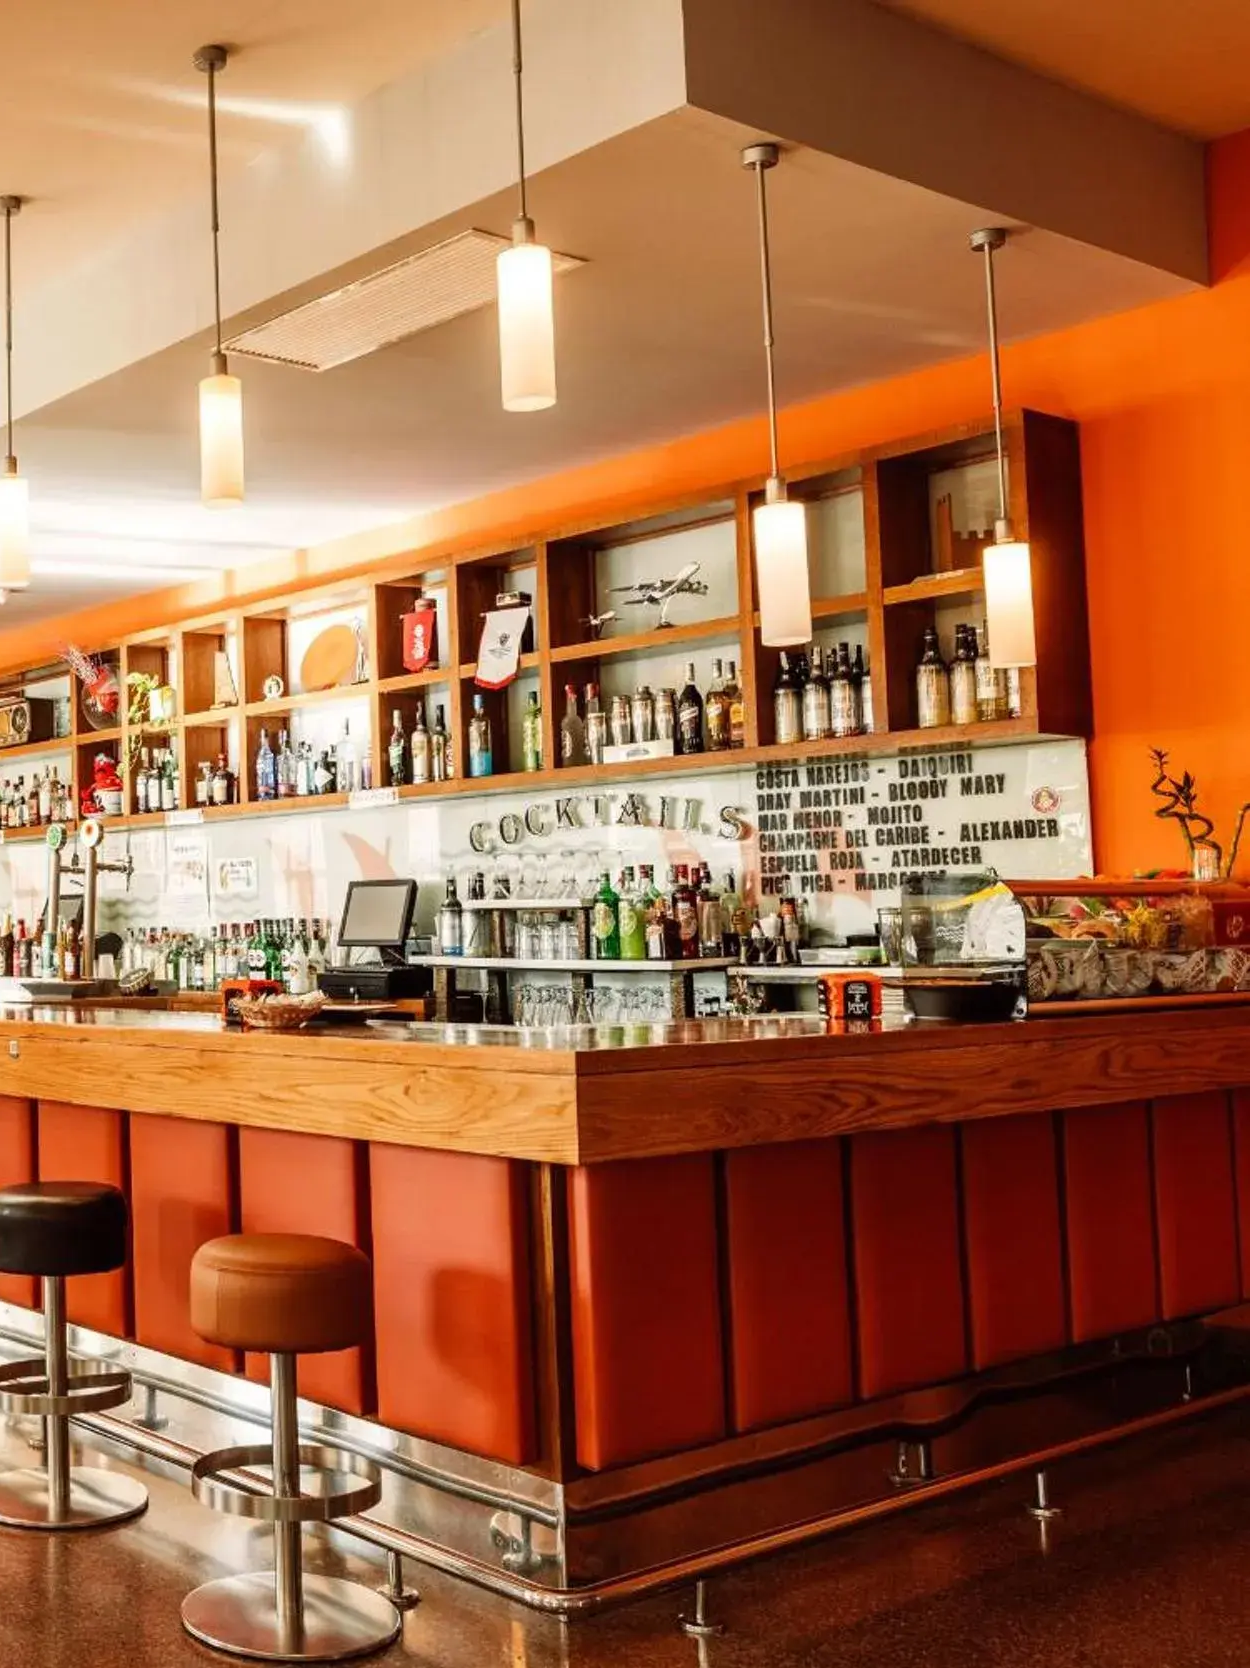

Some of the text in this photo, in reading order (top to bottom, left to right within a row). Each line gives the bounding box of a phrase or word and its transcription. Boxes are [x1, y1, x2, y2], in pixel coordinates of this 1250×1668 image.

[756, 769, 800, 790] COSTA
[806, 762, 870, 785] NAREJOS
[898, 754, 973, 778] DAIQUIRI
[757, 793, 791, 811] DRAY
[800, 786, 865, 808] MARTINI
[888, 779, 947, 802] BLOODY
[960, 774, 1006, 796] MARY
[469, 793, 747, 852] COCKTAILS
[758, 813, 787, 832] MAR
[793, 809, 842, 830] MENOR
[867, 804, 922, 825] MOJITO
[759, 831, 837, 853] CHAMPAGNE
[845, 829, 869, 848] DEL
[875, 826, 929, 846] CARIBE
[960, 819, 1059, 842] ALEXANDER
[760, 854, 818, 873] ESPUELA
[829, 851, 865, 870] ROJA
[891, 846, 982, 867] ATARDECER
[801, 874, 833, 893] PICA
